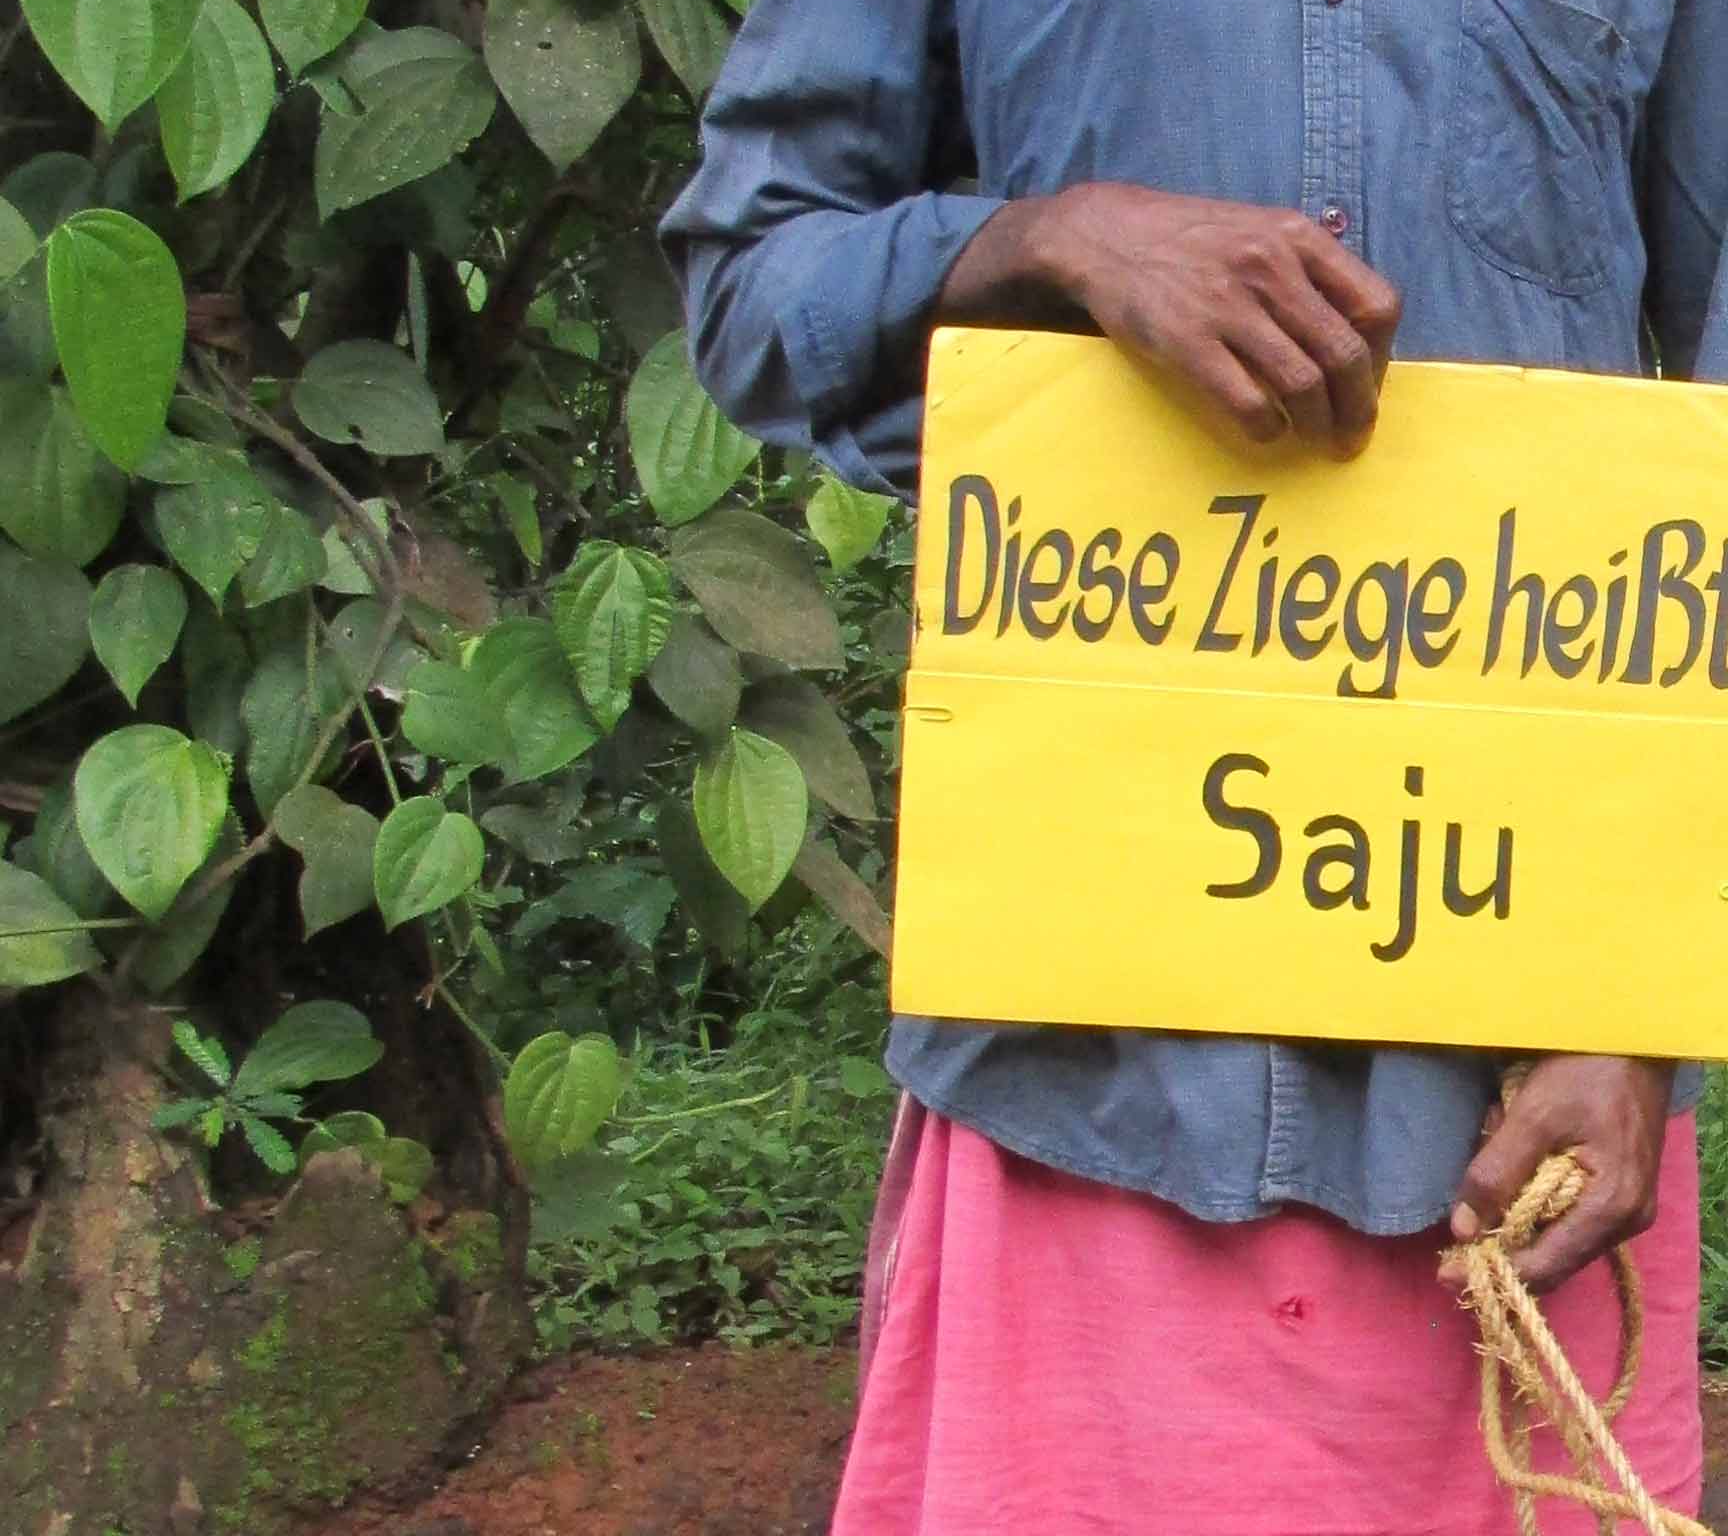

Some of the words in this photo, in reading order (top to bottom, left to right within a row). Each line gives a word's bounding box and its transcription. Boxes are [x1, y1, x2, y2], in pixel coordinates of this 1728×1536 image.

[941, 473, 1181, 647] Diese
[1193, 492, 1467, 700] Ziege
[1201, 751, 1514, 963] Saju
